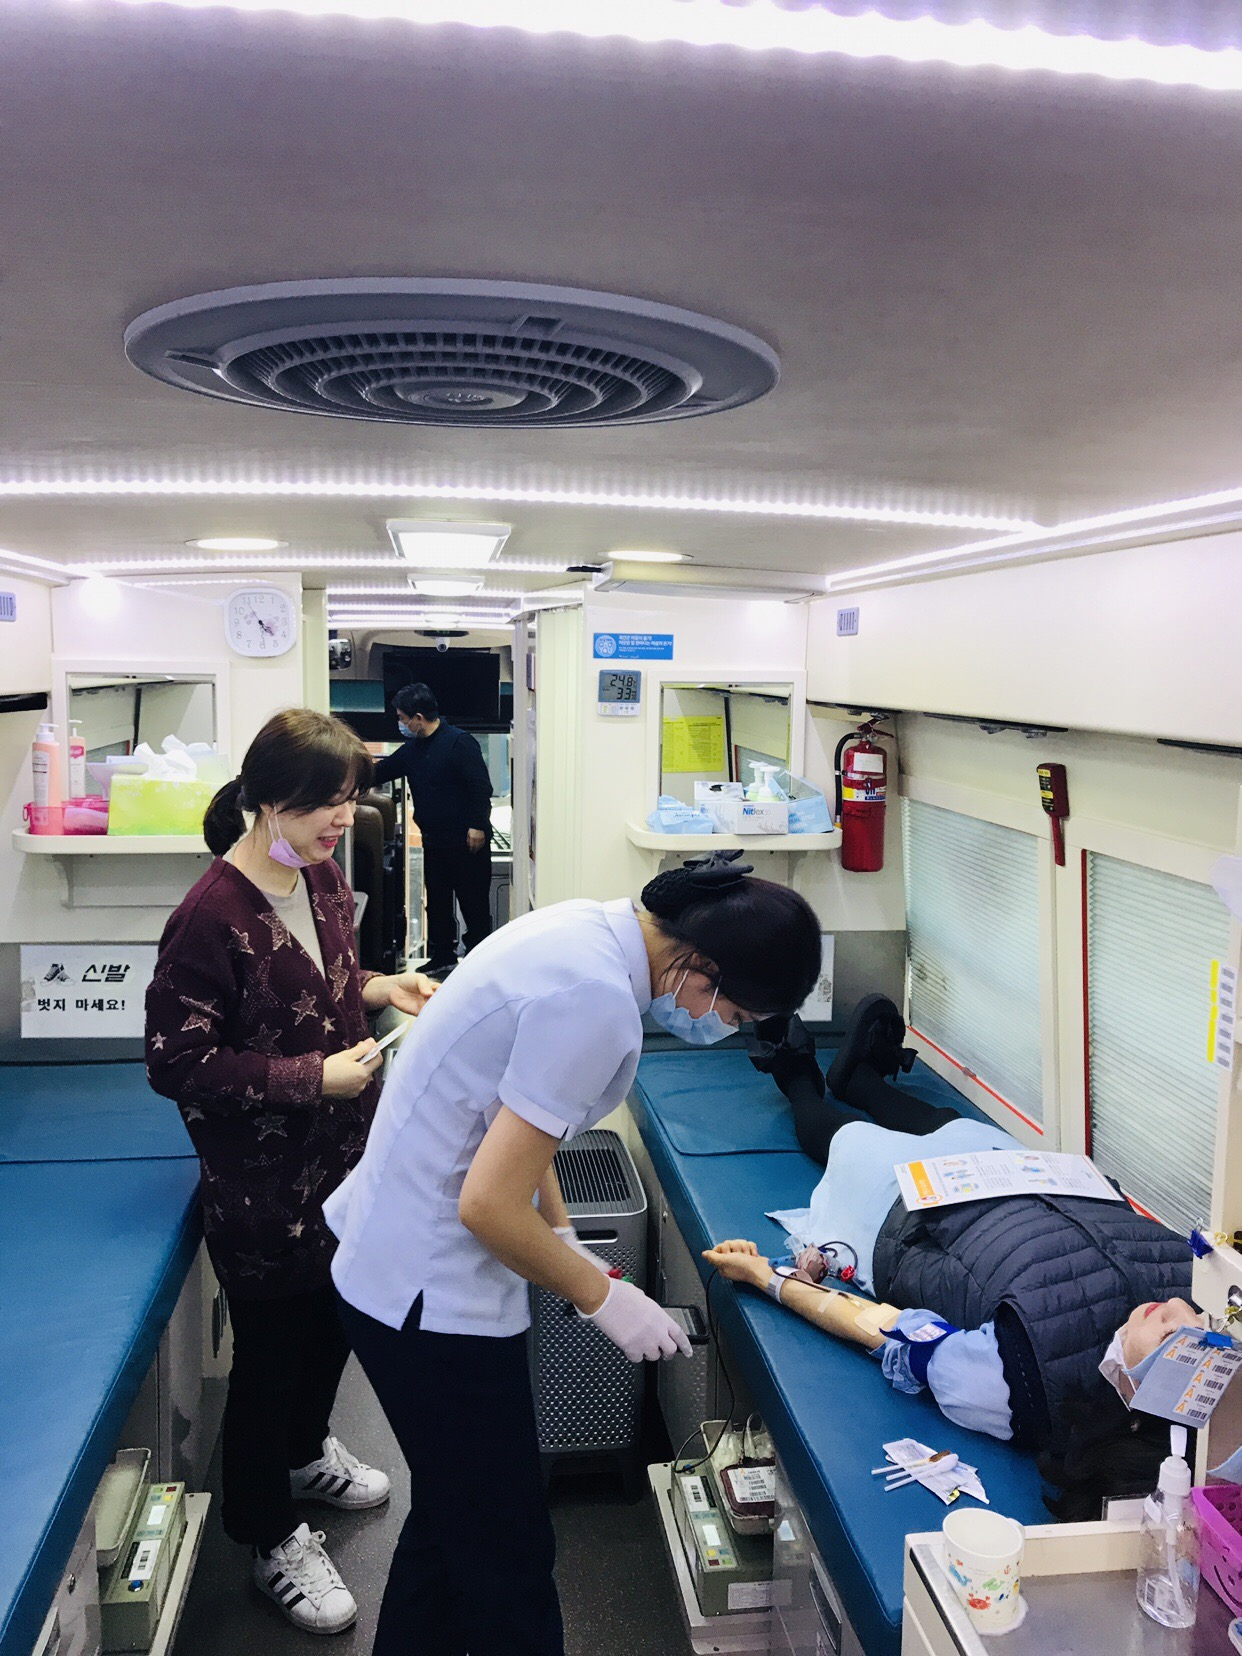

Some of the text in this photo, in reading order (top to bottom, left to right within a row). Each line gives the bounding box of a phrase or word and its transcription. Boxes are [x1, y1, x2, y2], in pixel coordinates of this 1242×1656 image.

[254, 595, 264, 604] 12
[234, 606, 245, 615] 10
[610, 674, 633, 687] 24.8
[616, 687, 632, 700] 33
[82, 964, 130, 982] 신발
[38, 998, 126, 1011] 벗지 마세요!
[1176, 1337, 1187, 1346] A
[1165, 1348, 1176, 1359] A
[1202, 1359, 1212, 1369] A
[1193, 1372, 1203, 1384] A
[1184, 1387, 1194, 1398] A
[1175, 1401, 1186, 1412] A
